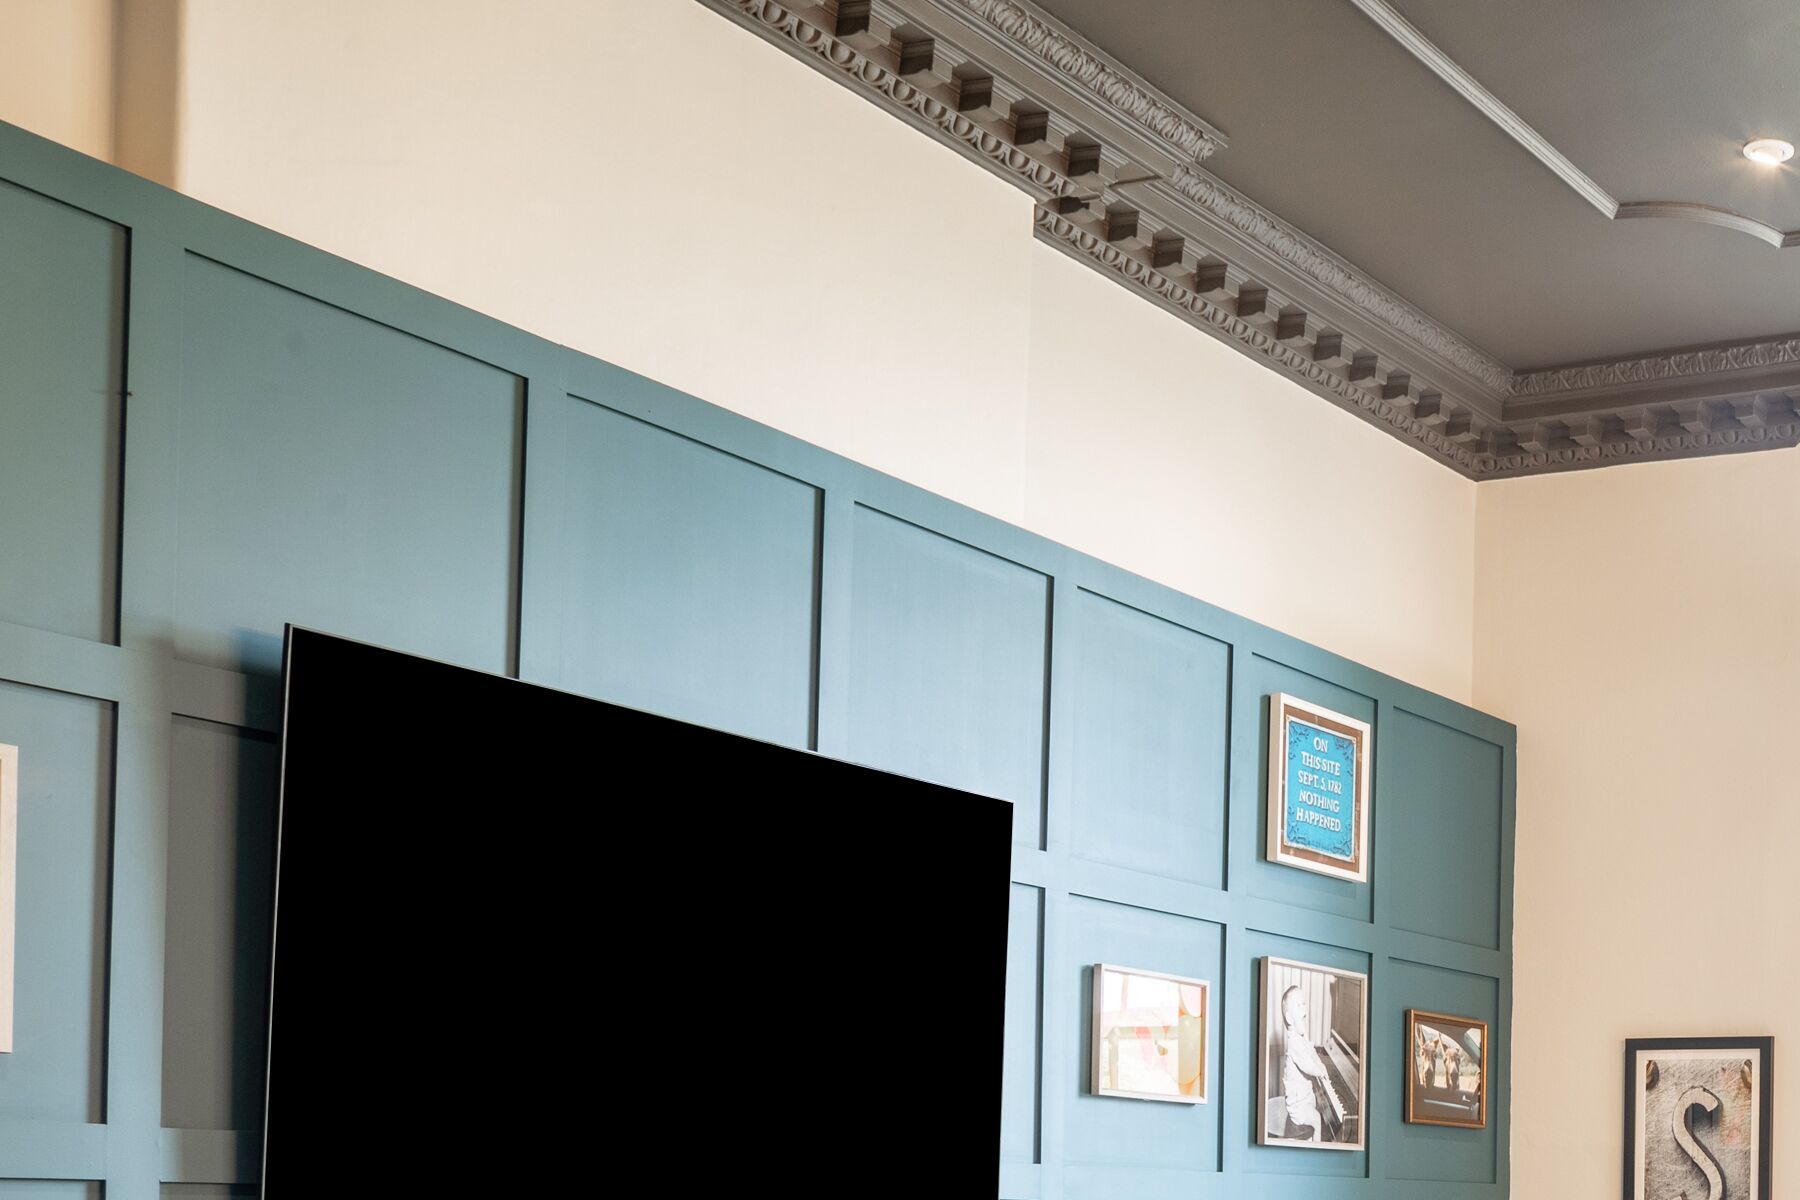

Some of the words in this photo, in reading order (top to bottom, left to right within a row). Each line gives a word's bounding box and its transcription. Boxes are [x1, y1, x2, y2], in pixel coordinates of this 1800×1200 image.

[1314, 737, 1328, 753] ON
[1301, 751, 1321, 770] THIS
[1321, 759, 1341, 776] SITE
[1298, 770, 1319, 788] SEPT.
[1320, 777, 1327, 792] 5,
[1328, 779, 1342, 795] 1782
[1299, 789, 1340, 813] NOTHING
[1296, 806, 1341, 832] HAPPENED
